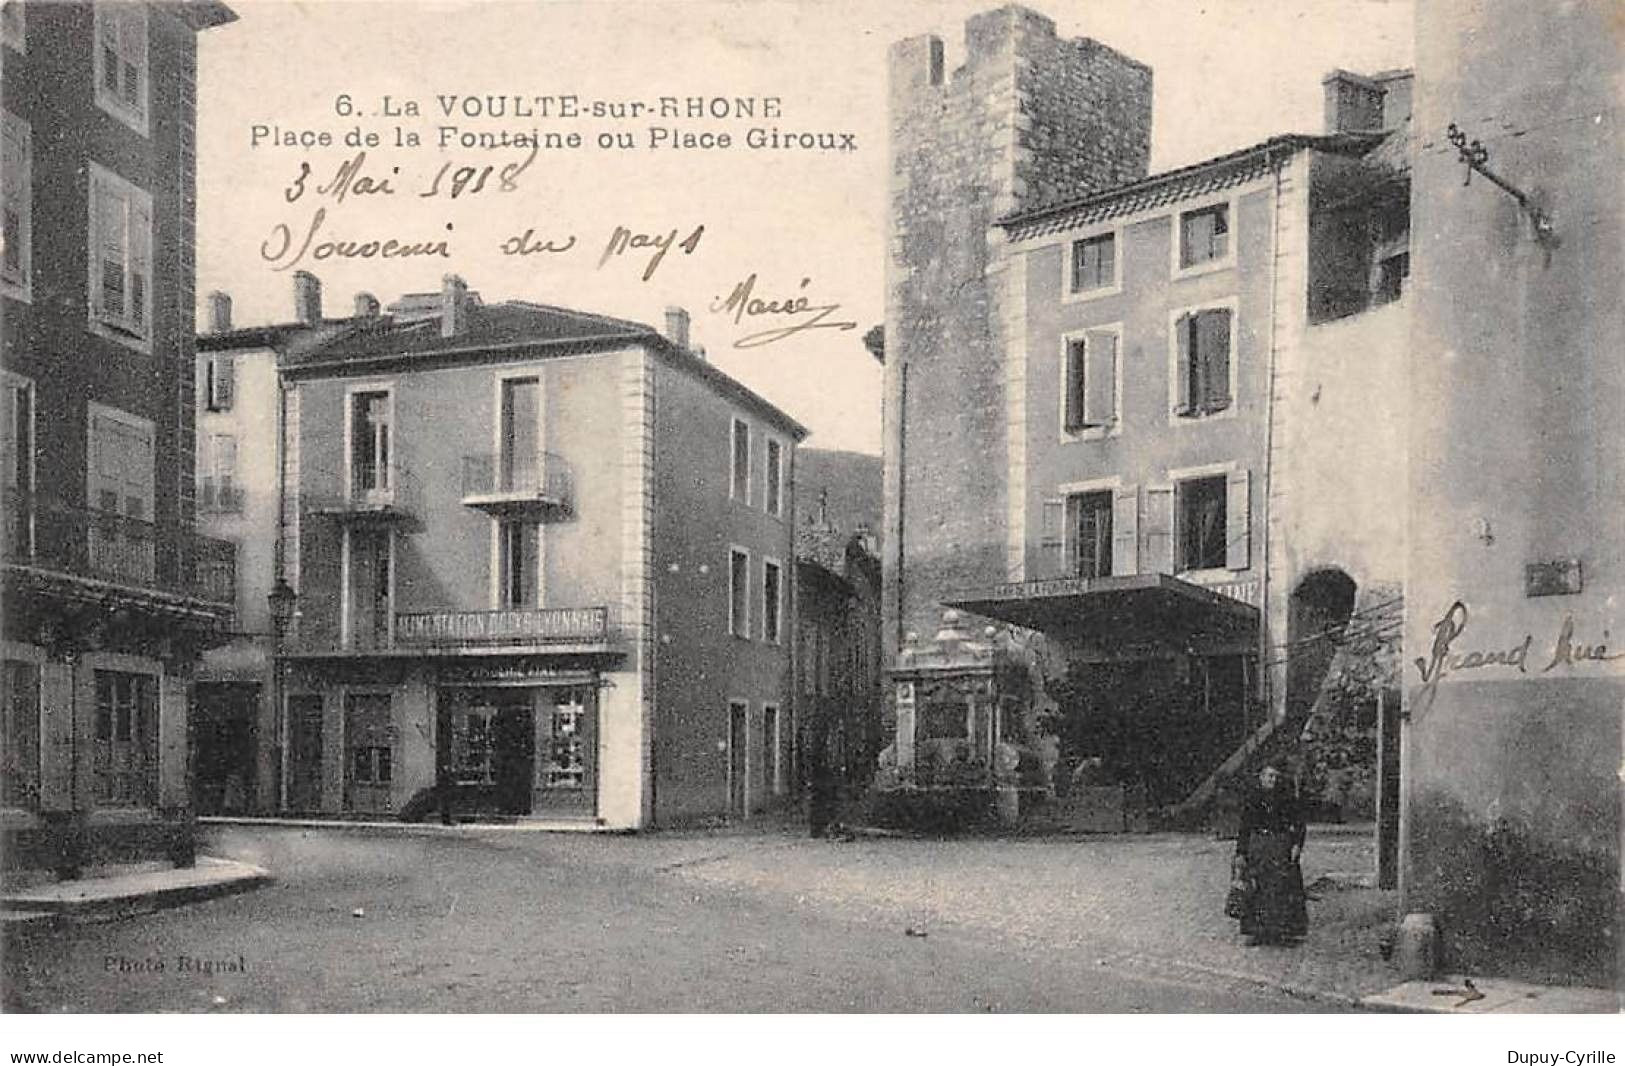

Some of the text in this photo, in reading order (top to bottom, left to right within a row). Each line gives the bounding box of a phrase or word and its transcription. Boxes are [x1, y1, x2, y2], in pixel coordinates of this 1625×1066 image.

[285, 161, 310, 203] 3
[317, 151, 394, 204] Mai
[500, 228, 577, 257] du
